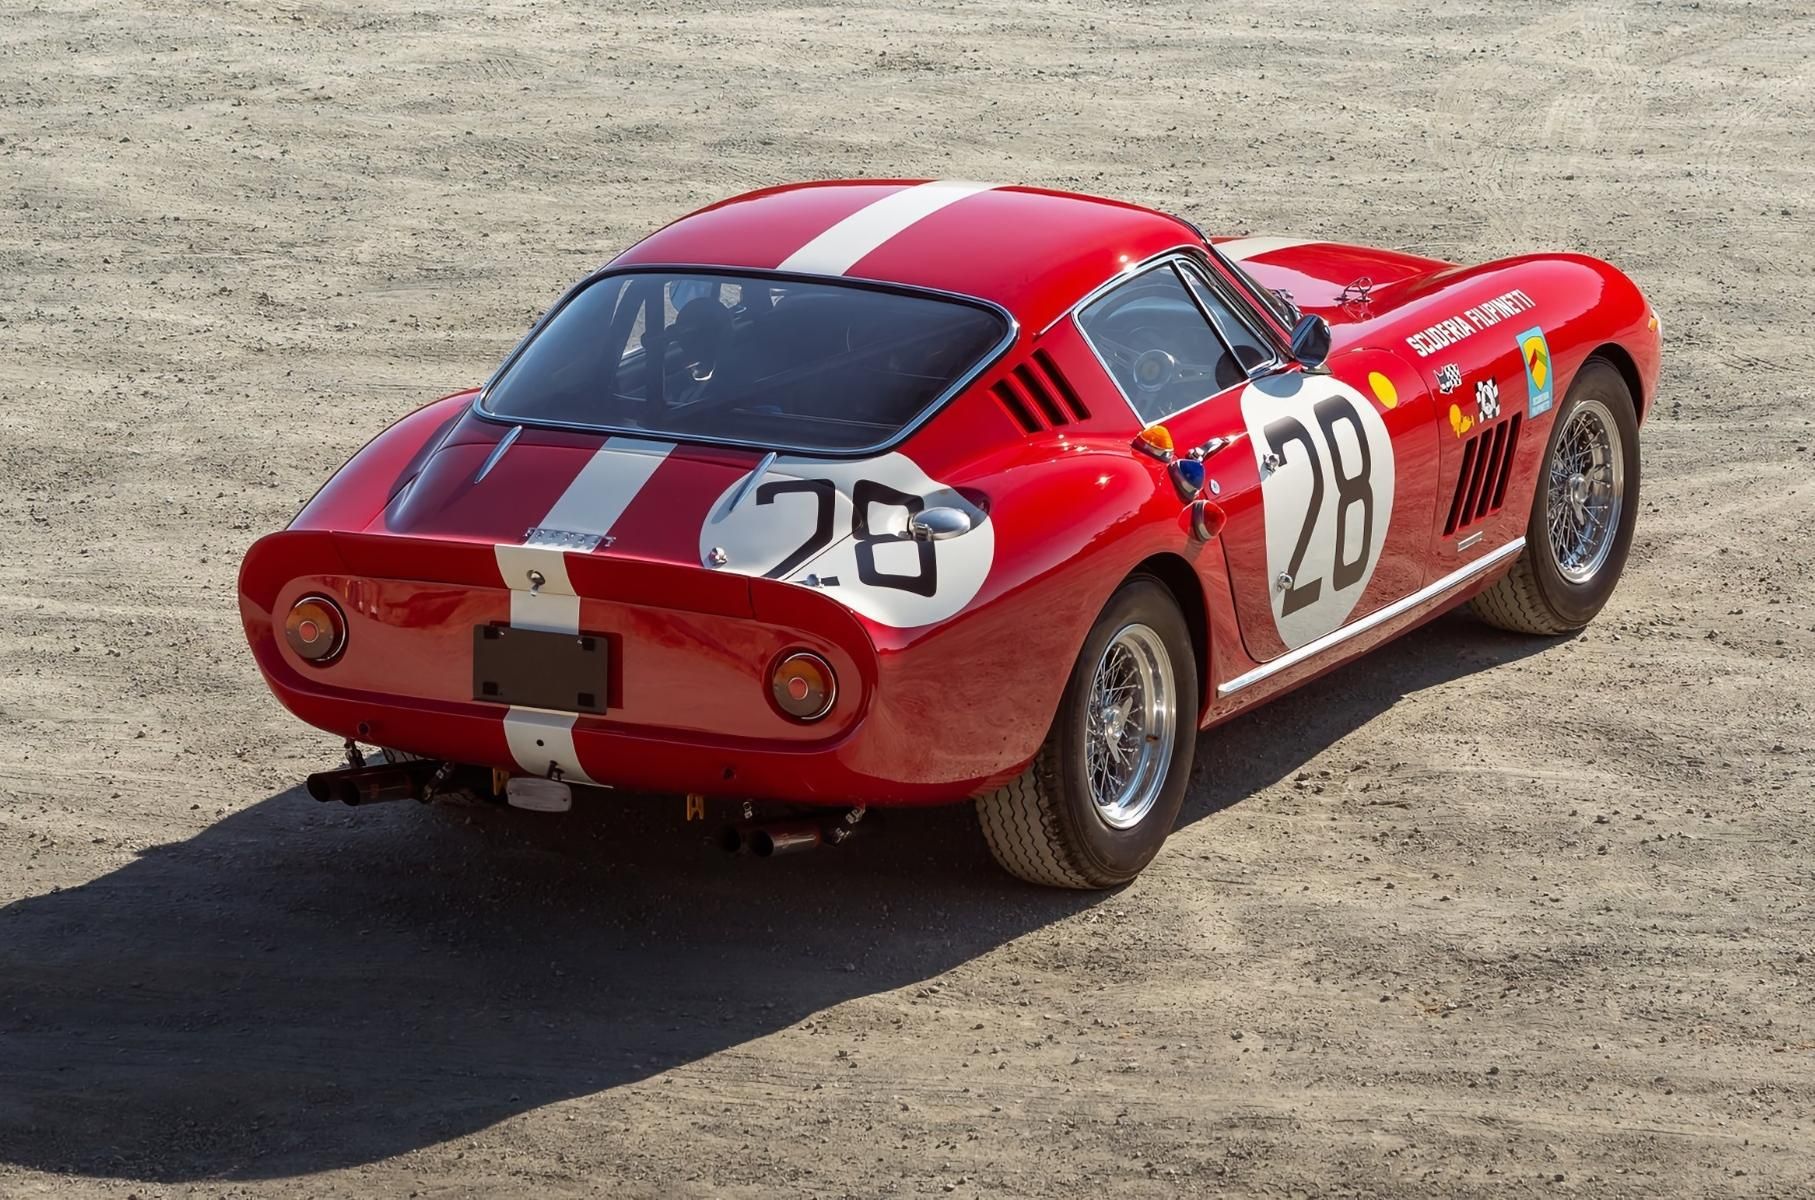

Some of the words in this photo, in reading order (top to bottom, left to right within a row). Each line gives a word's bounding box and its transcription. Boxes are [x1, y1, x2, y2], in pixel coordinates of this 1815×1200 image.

[1405, 316, 1477, 358] SCUDERIA
[1464, 289, 1536, 330] FILIPINETTI
[756, 479, 937, 597] 28
[1264, 395, 1374, 617] 28
